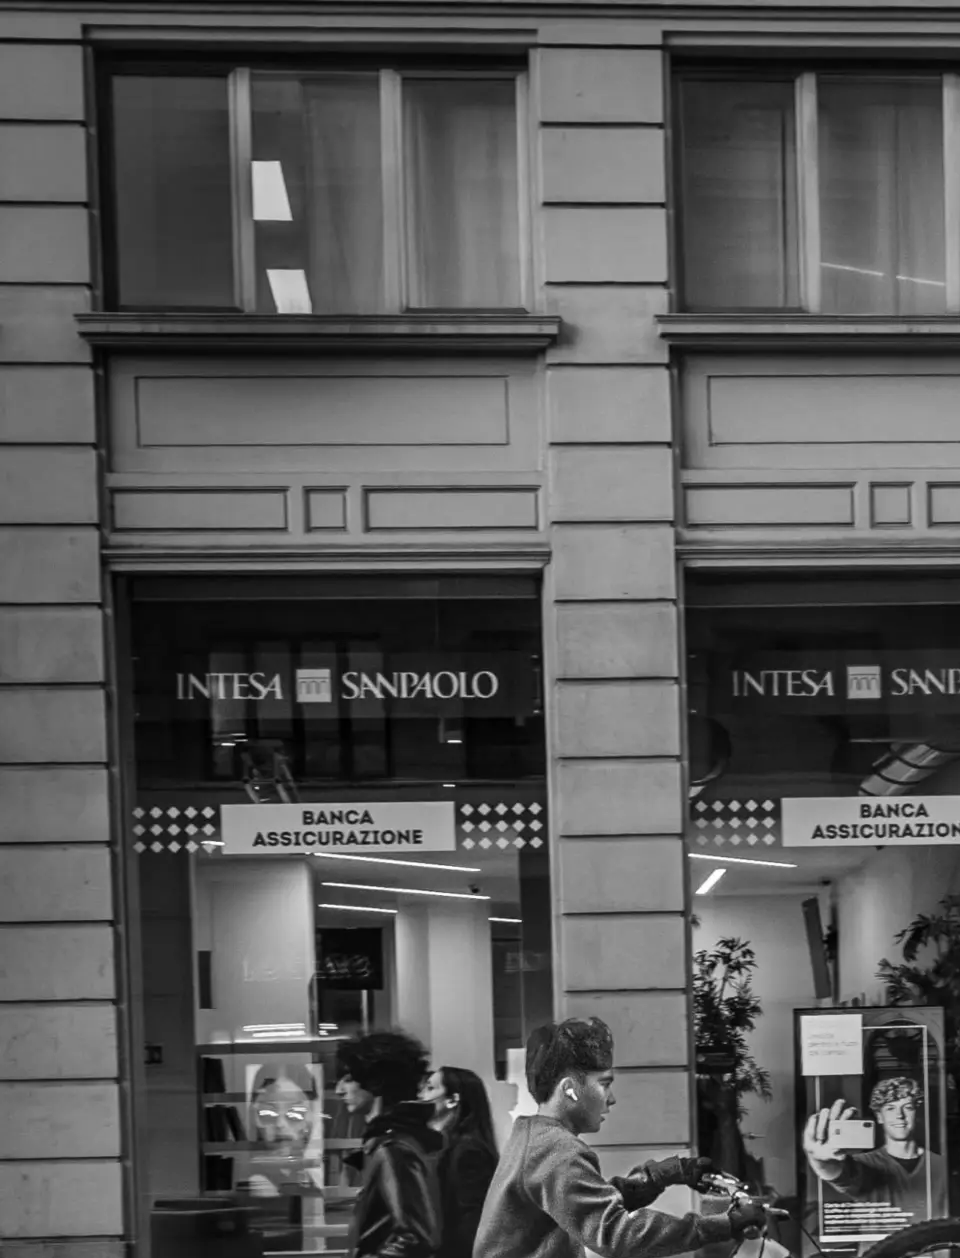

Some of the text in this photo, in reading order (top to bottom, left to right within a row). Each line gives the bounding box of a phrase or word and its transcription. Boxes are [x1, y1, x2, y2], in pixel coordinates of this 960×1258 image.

[176, 671, 499, 700] INTESA SANPAOLO
[731, 669, 835, 697] INTESA
[302, 809, 375, 826] BANCA
[859, 803, 930, 819] BANCA
[251, 829, 424, 848] ASSICURAZIONE
